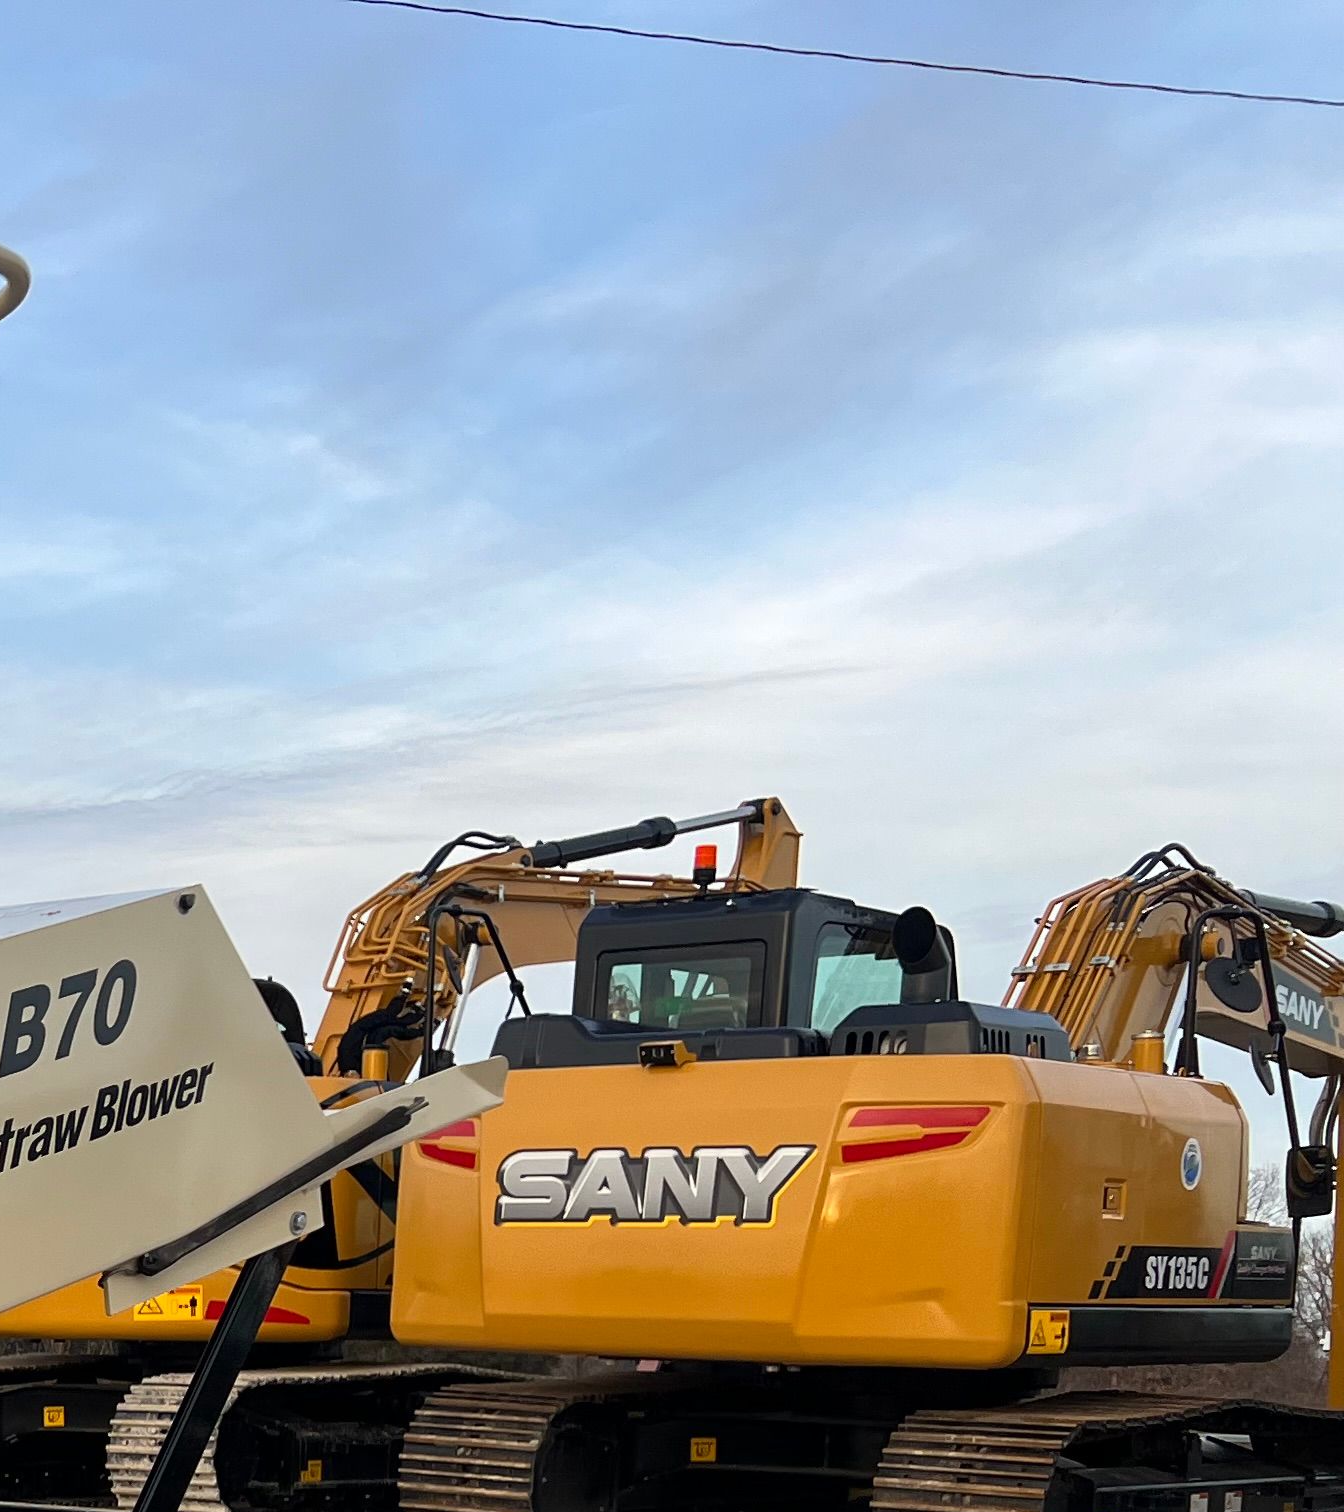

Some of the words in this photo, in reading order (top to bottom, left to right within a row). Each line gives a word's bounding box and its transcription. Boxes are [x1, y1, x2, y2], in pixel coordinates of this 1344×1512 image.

[1275, 984, 1325, 1030] SANY
[88, 1061, 215, 1142] Blower
[495, 1145, 816, 1226] SANY
[1144, 1255, 1210, 1290] SY135C
